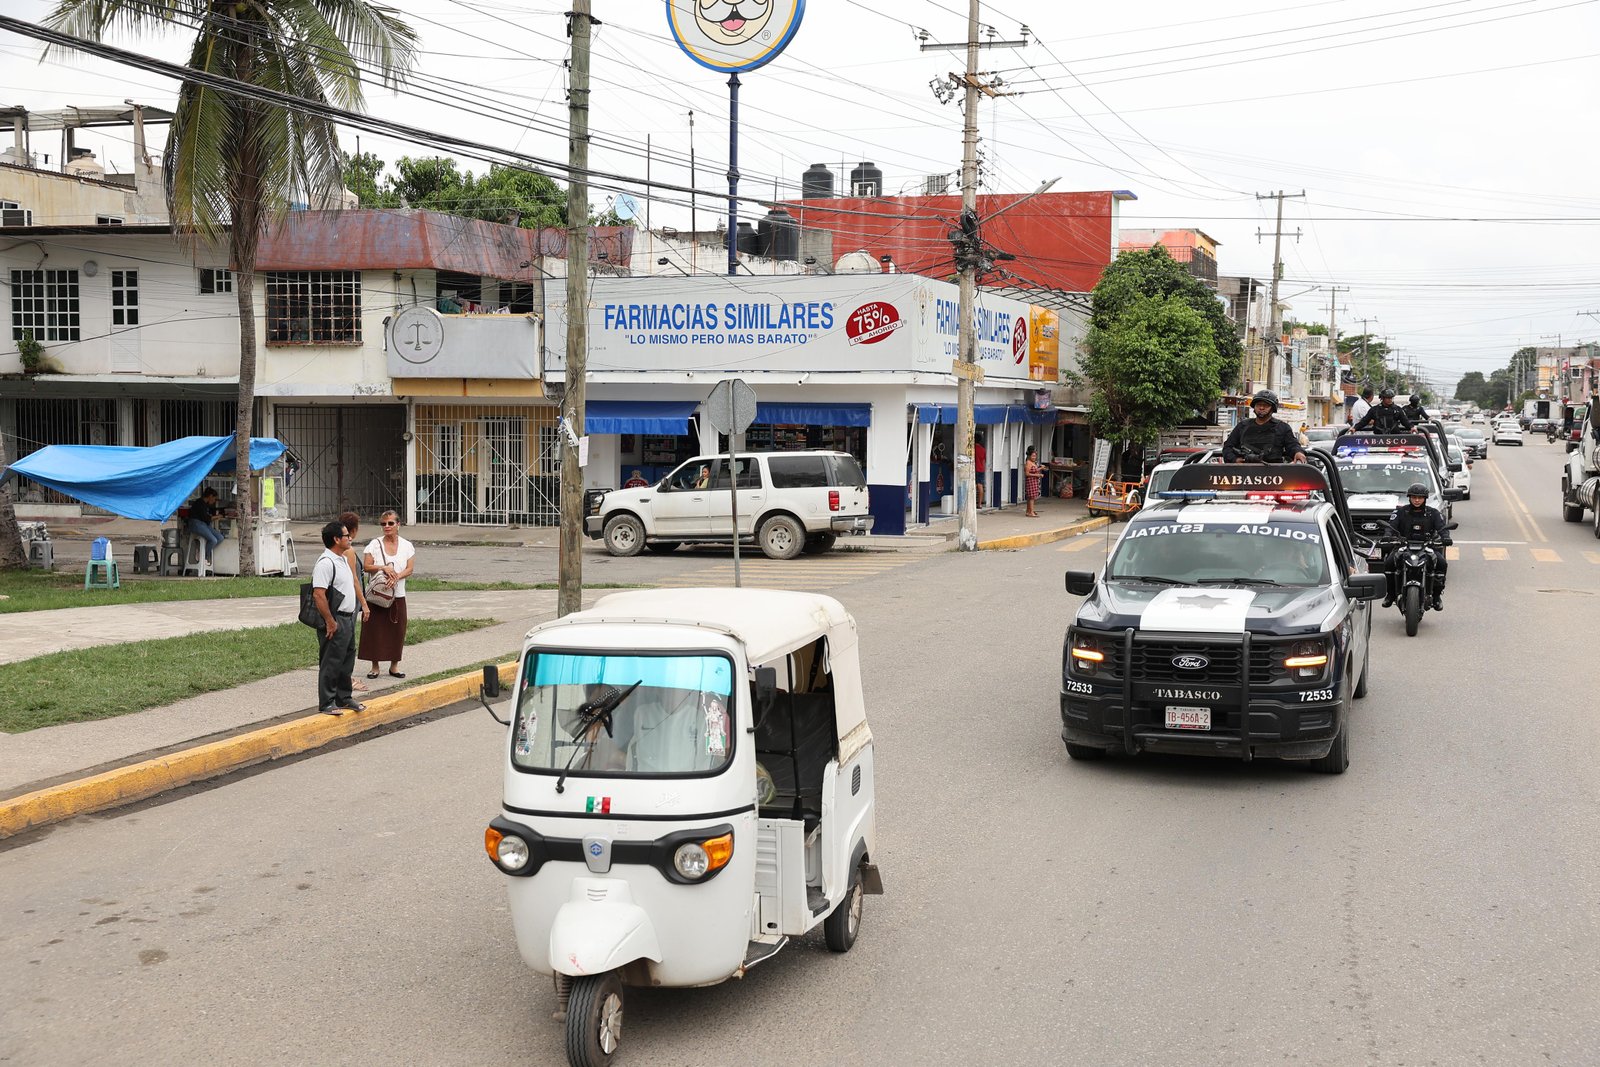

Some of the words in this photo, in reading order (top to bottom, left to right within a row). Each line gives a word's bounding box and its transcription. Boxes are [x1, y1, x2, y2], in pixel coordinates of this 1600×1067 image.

[604, 303, 718, 330] FARMACIAS
[724, 302, 834, 330] SIMILARES
[856, 304, 878, 316] HASTA
[853, 307, 890, 334] 75%
[868, 322, 898, 338] AHORRO
[624, 334, 646, 345] "LO
[649, 334, 688, 345] MISMO
[691, 334, 724, 345] PERO
[727, 334, 754, 345] MAS
[757, 333, 813, 345] BARATO"
[1355, 438, 1408, 446] TABASCO
[1209, 475, 1284, 485] TABASCO
[1177, 657, 1202, 667] Ford
[1066, 680, 1093, 694] 72533
[1153, 688, 1221, 700] TABASCO
[1299, 689, 1333, 702] 72533
[1166, 711, 1209, 724] TB-456A-2
